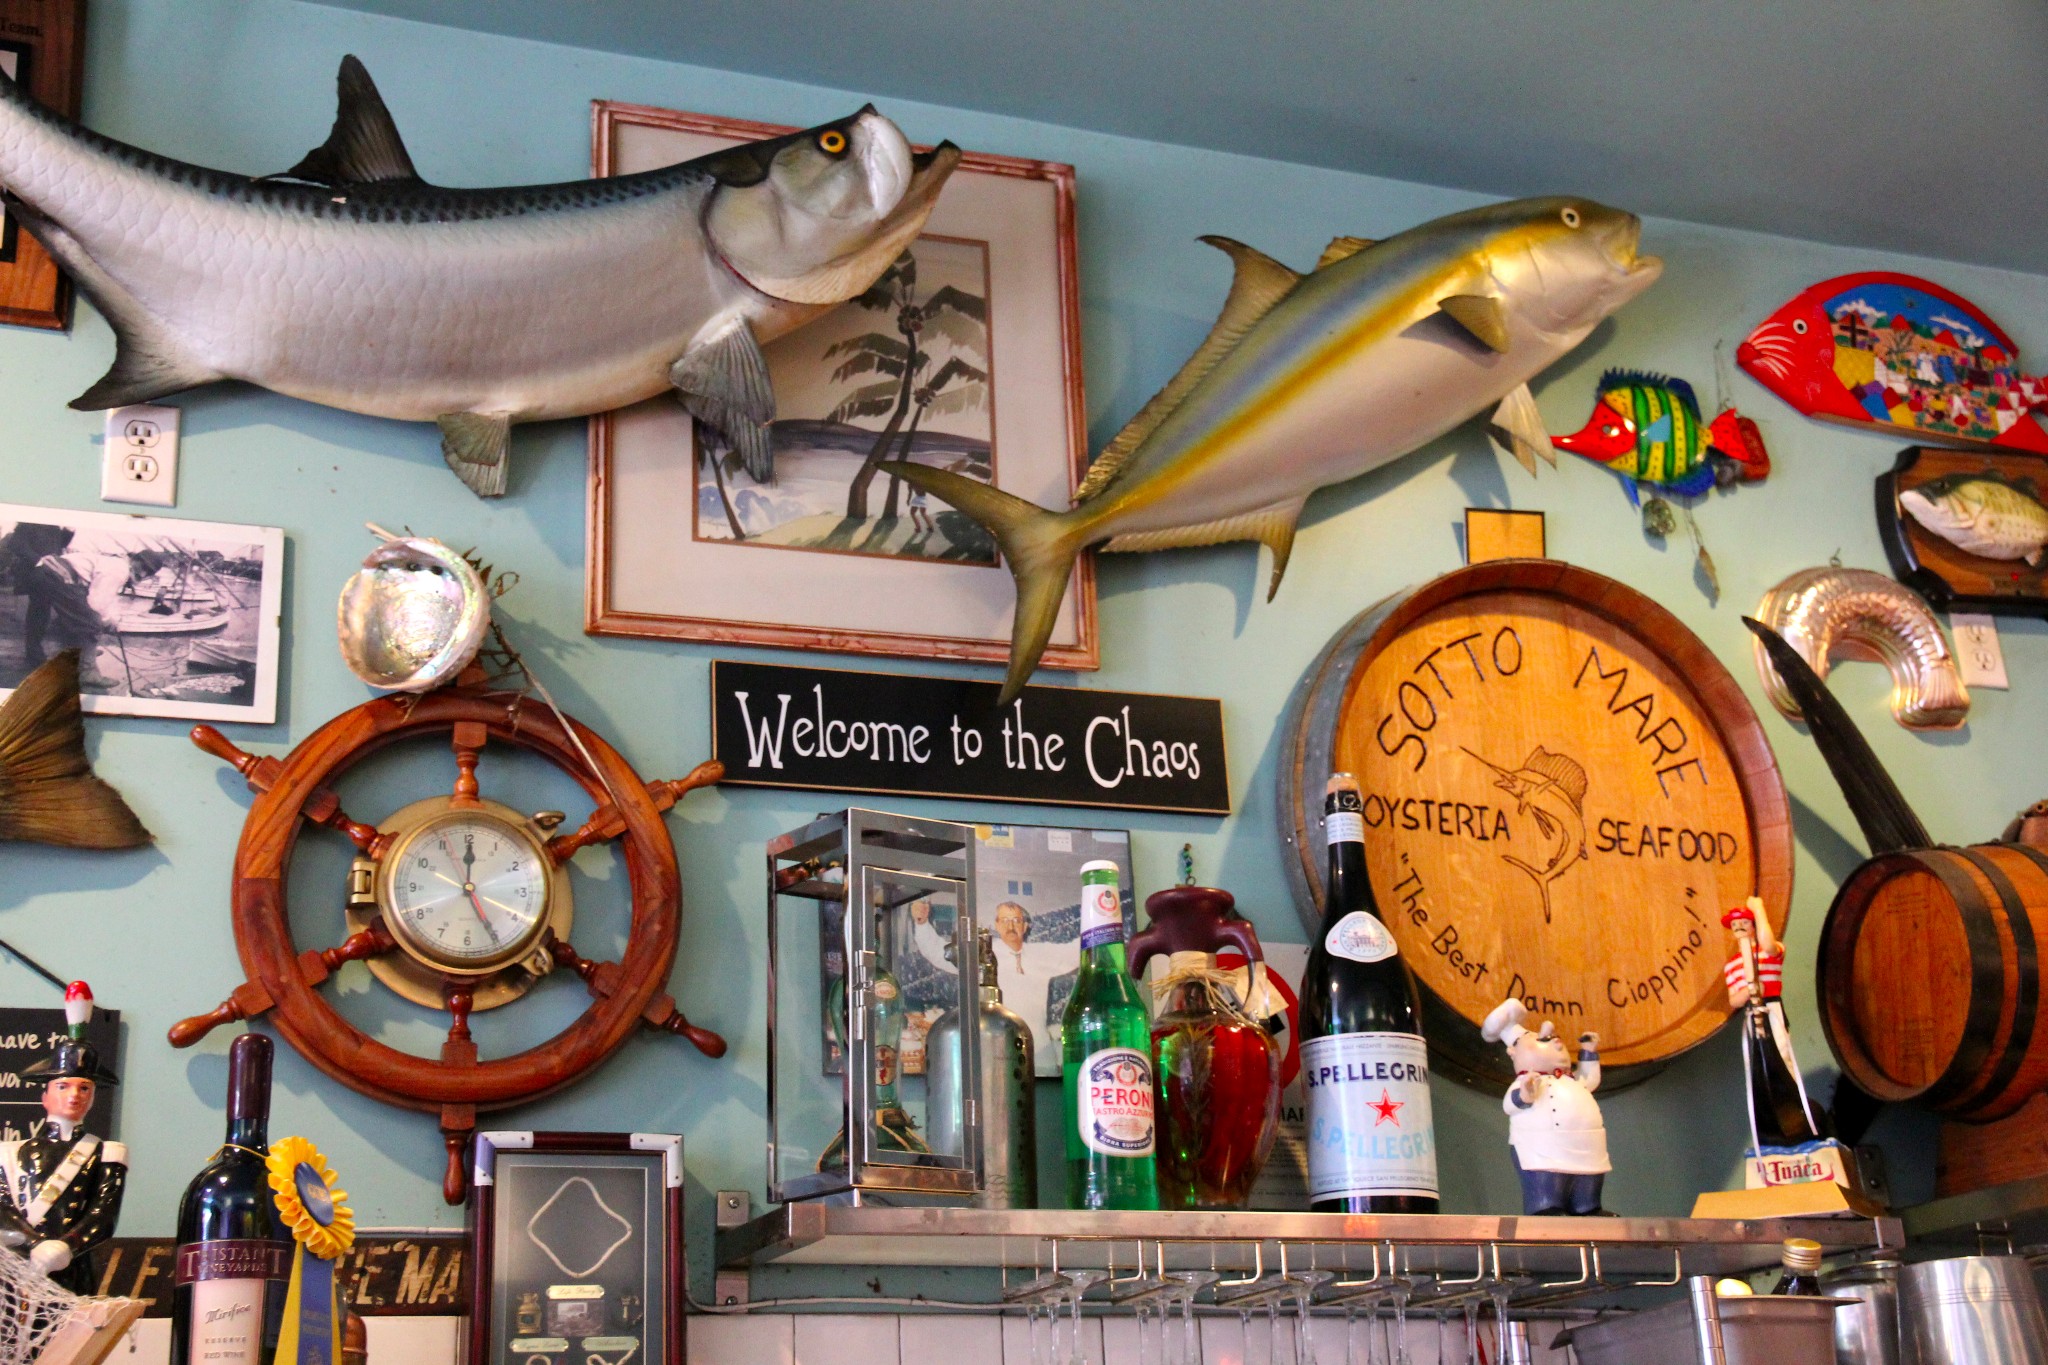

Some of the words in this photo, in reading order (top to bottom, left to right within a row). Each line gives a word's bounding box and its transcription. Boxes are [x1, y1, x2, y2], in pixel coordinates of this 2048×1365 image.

[1377, 626, 1522, 772] SOTTO
[1573, 646, 1708, 799] MARE
[734, 684, 931, 769] Welcome
[950, 714, 982, 765] to
[1002, 698, 1066, 771] the
[1084, 705, 1200, 788] Chaos
[1362, 794, 1511, 841] OYSTERIA
[1595, 817, 1738, 864] SEAFOOD
[512, 861, 519, 871] 2
[409, 883, 417, 892] 9
[520, 888, 527, 898] 3
[416, 909, 425, 920] 8
[437, 929, 445, 938] 7
[464, 936, 471, 946] 6
[1431, 925, 1488, 984] Best
[1506, 974, 1583, 1016] Damn
[0, 1032, 42, 1049] ave
